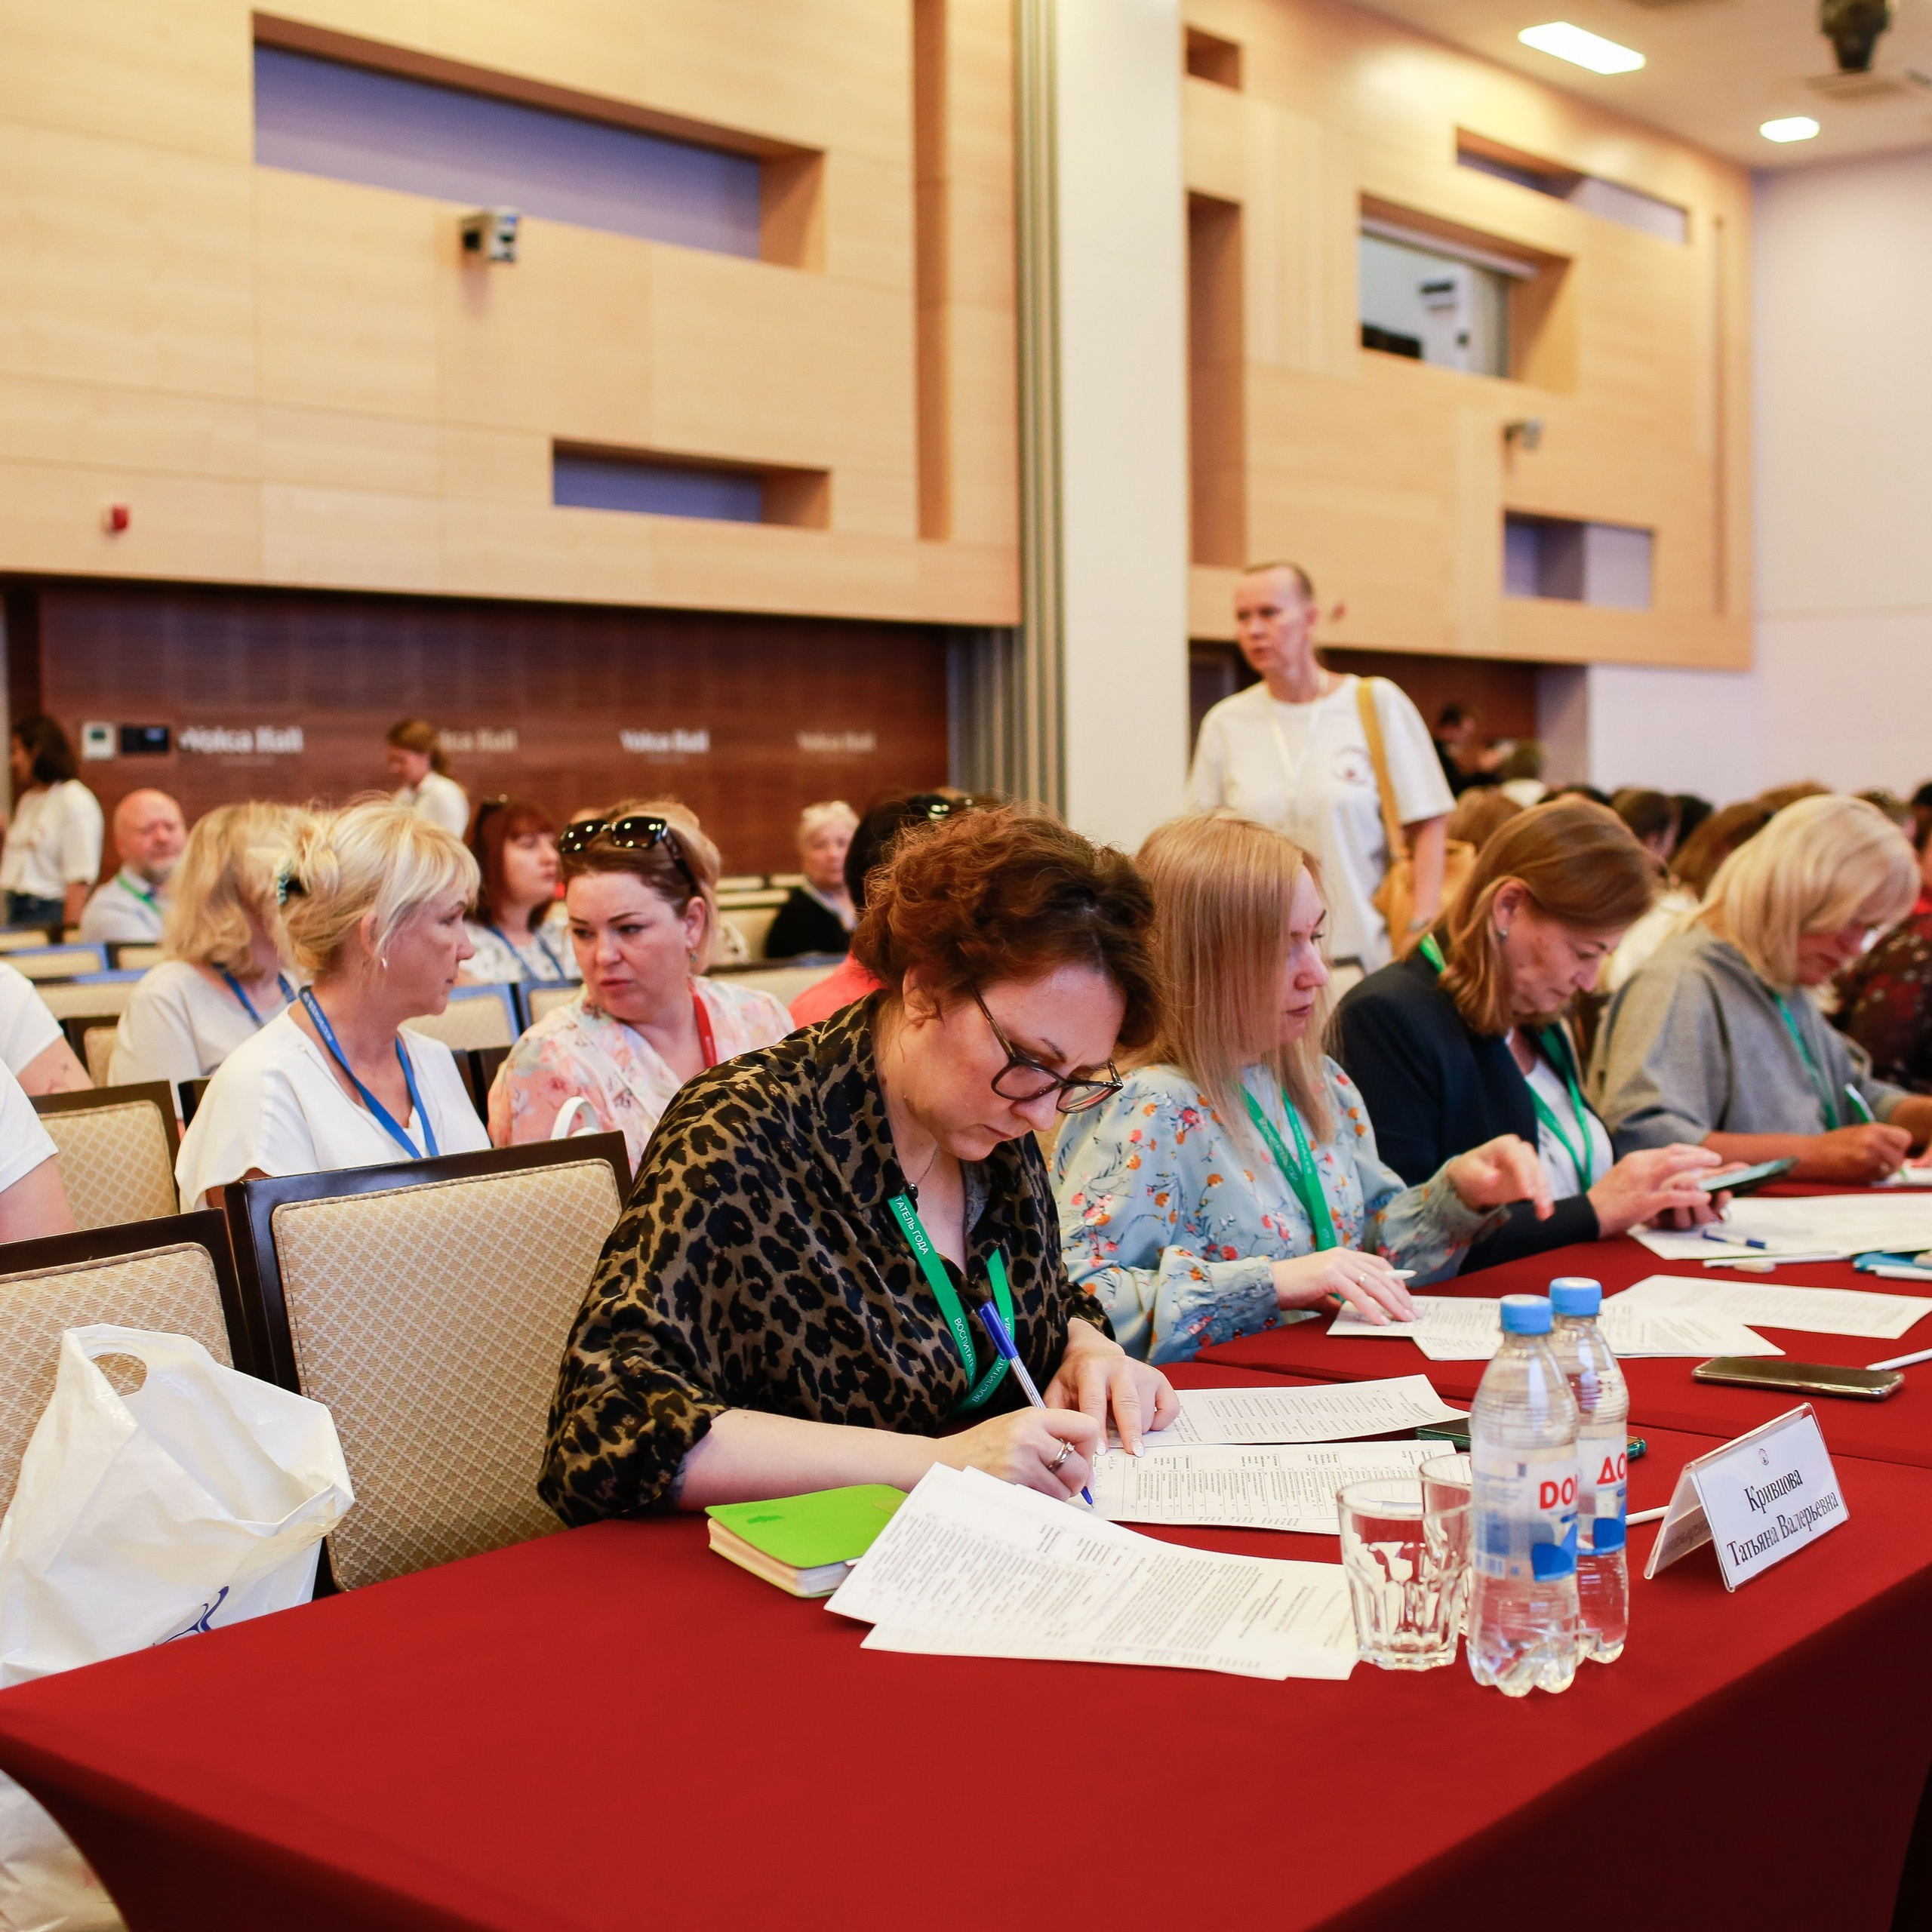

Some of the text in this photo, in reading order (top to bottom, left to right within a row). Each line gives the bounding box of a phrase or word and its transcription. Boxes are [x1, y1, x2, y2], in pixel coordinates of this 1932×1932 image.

[912, 1229, 930, 1255] ГОДА
[1743, 1468, 1804, 1515] Кривцова
[1726, 1527, 1780, 1567] Татьяна
[1776, 1491, 1839, 1540] Валерьевна
